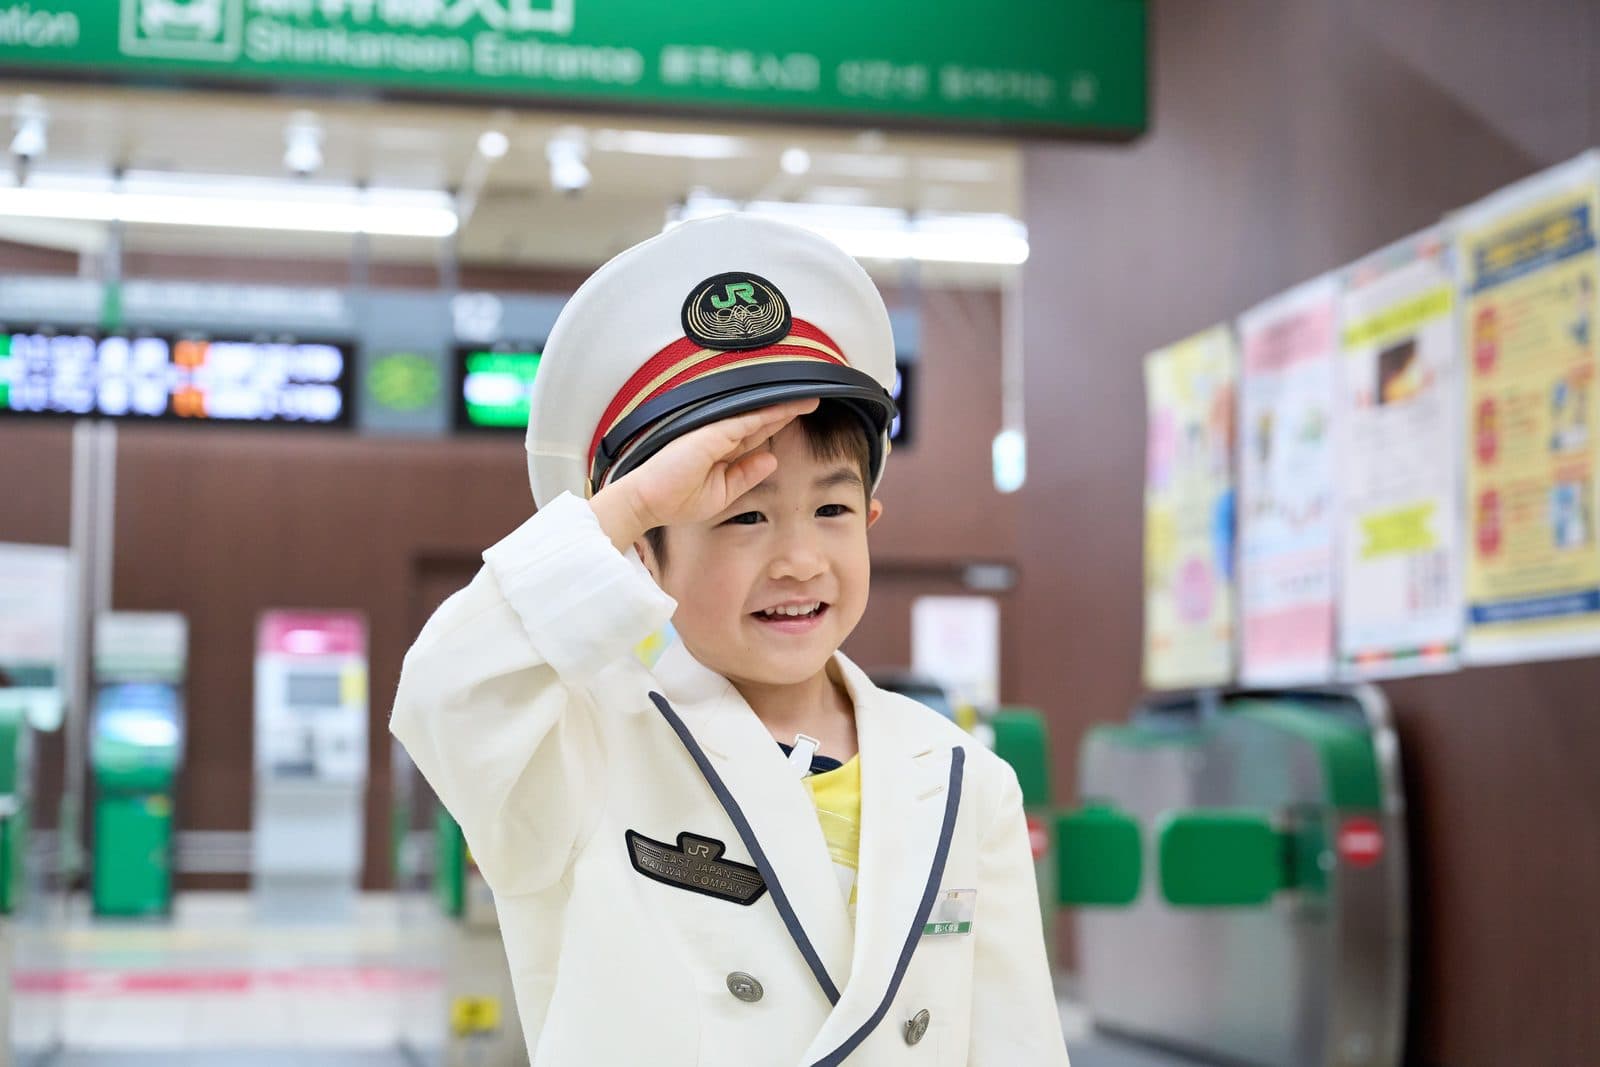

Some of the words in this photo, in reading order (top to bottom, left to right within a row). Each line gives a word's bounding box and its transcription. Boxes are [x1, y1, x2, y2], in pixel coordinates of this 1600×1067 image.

[711, 283, 758, 308] JR
[688, 845, 709, 858] JR
[640, 856, 690, 878] RAILWAY
[692, 873, 751, 896] COMPANY
[663, 853, 692, 868] EAST
[695, 863, 731, 878] JAPAN
